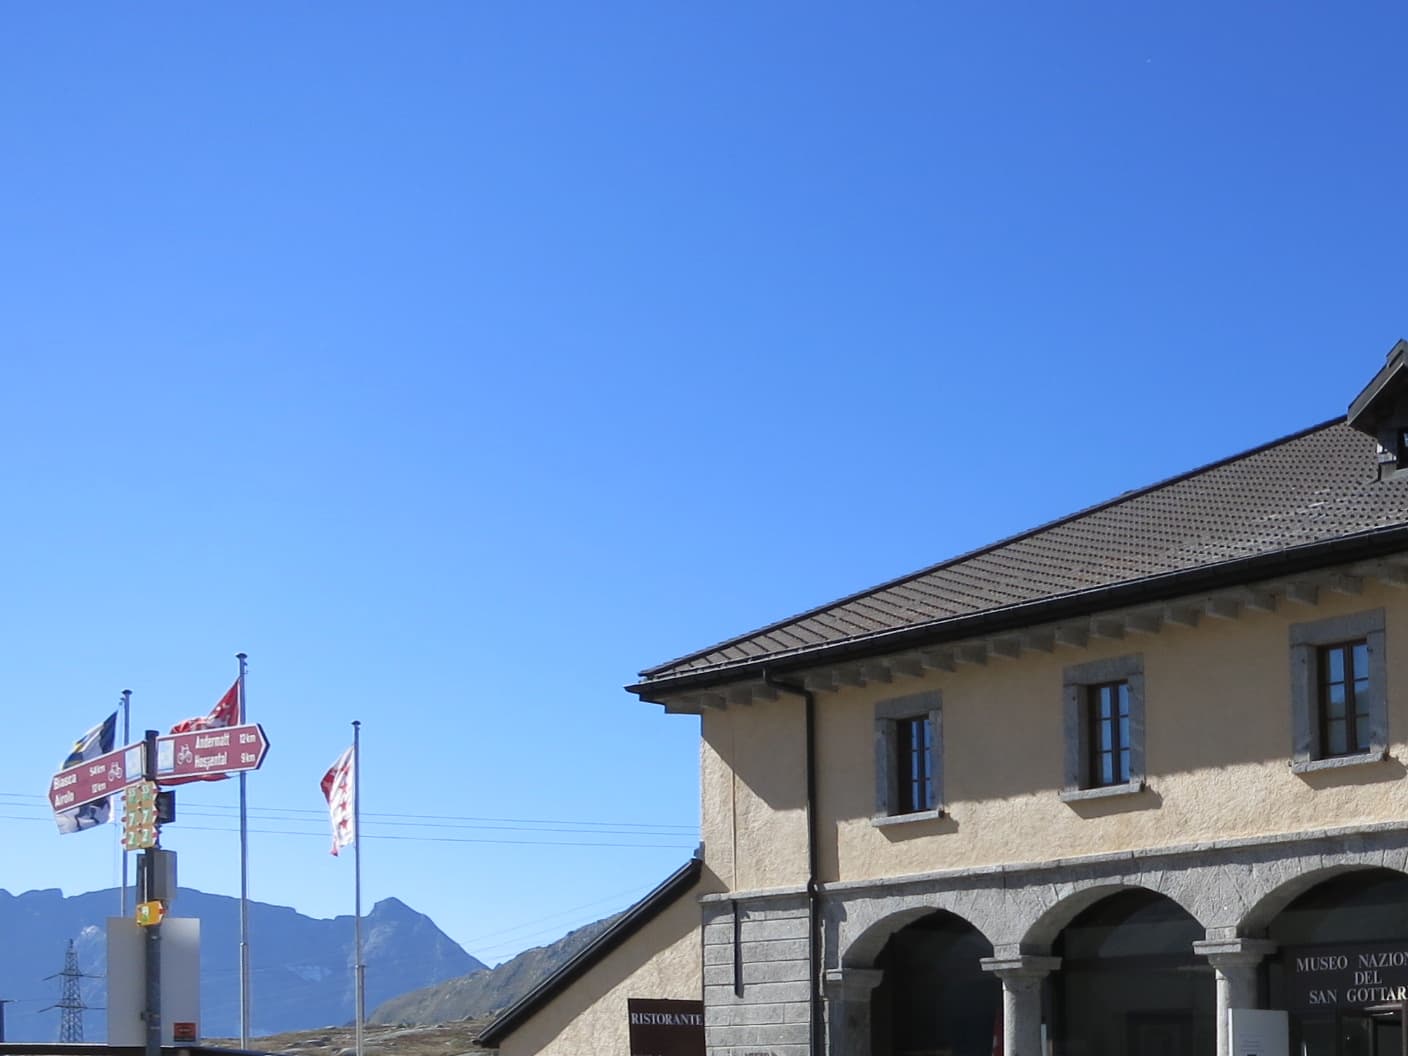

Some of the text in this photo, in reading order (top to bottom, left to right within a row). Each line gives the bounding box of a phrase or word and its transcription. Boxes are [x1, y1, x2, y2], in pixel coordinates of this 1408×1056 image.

[195, 732, 230, 749] Andermatt
[194, 752, 227, 770] Hospental
[53, 774, 77, 790] Biasca
[54, 791, 75, 807] Airolo
[1296, 955, 1348, 973] MUSEO
[1355, 970, 1383, 986] DEL
[1309, 989, 1337, 1004] SAN
[631, 1012, 703, 1026] RISTORANTE
